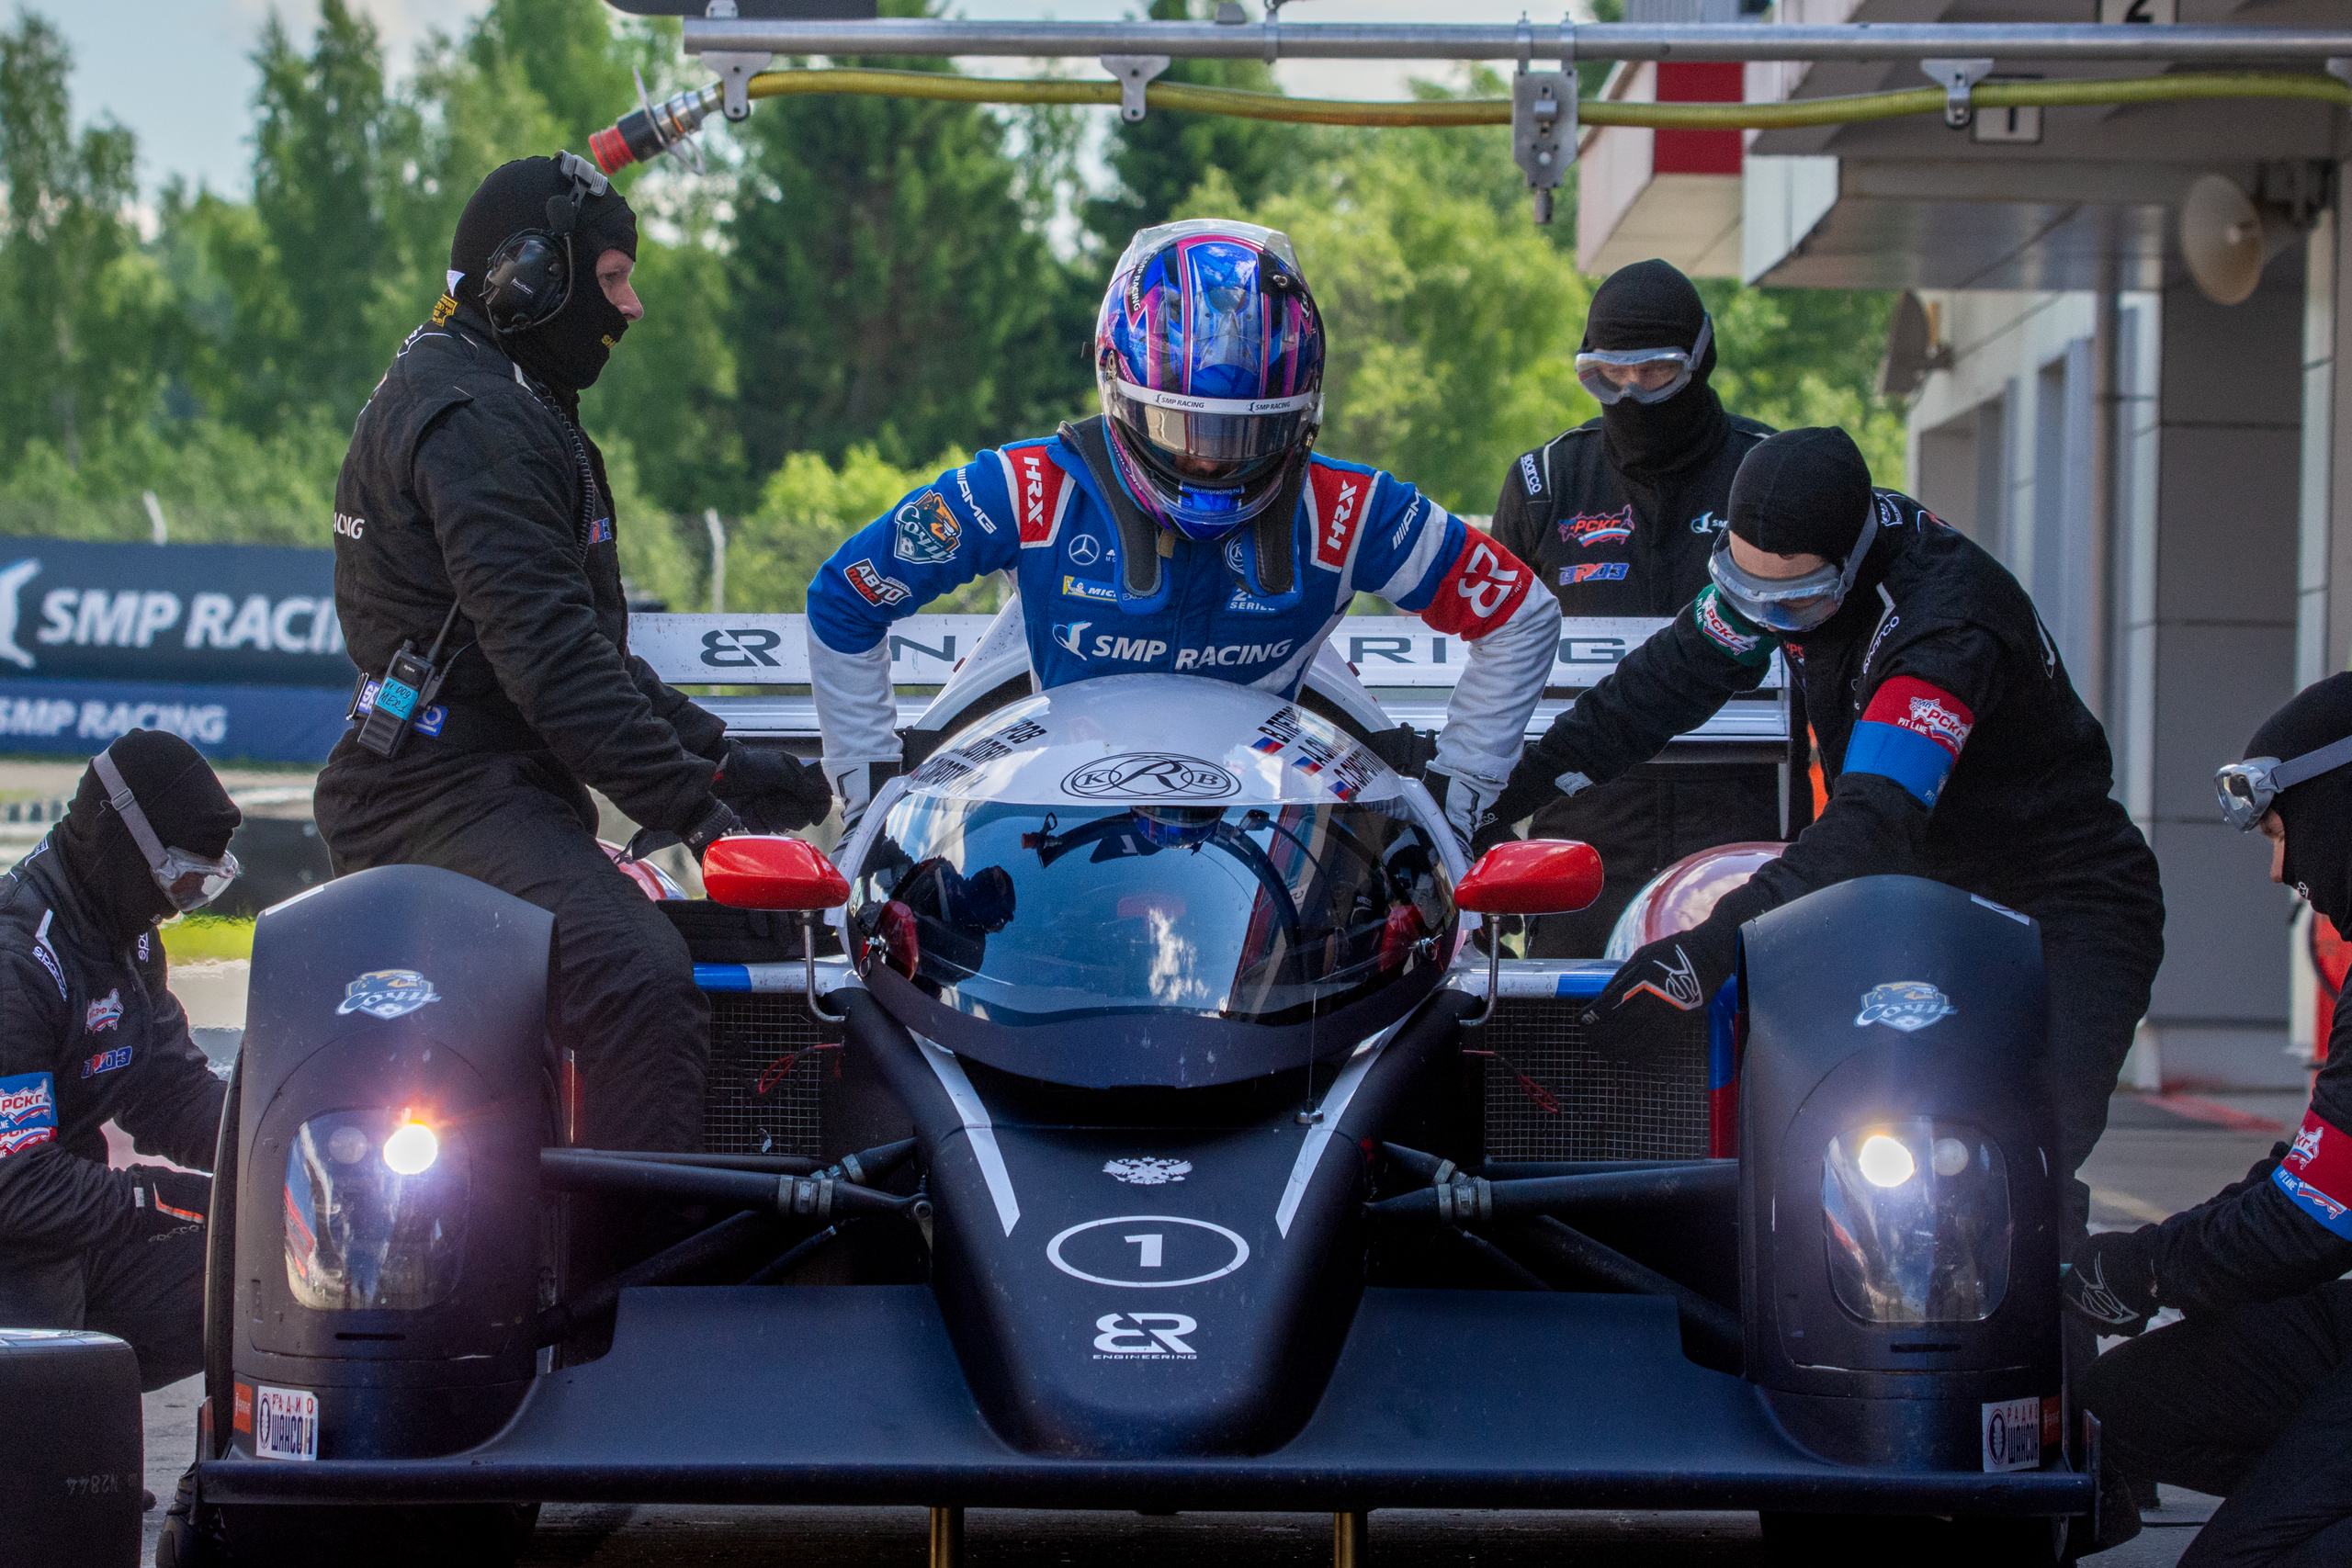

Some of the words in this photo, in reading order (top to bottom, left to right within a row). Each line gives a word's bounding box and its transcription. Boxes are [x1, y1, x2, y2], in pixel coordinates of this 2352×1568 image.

[1132, 275, 1142, 311] RACING
[1161, 396, 1176, 405] SMP
[1177, 398, 1204, 408] RACING
[1255, 402, 1271, 411] SMP
[1271, 400, 1291, 410] RACING
[1023, 456, 1044, 526] HRX
[1521, 454, 1543, 496] sparco
[957, 479, 998, 535] AMG
[1327, 479, 1358, 551] HRX
[1713, 519, 1729, 528] SM
[847, 568, 878, 601] ПЛЮС
[856, 565, 904, 602] АВТО
[37, 588, 182, 648] SMP
[1707, 608, 1744, 642] РСКГ
[1091, 635, 1167, 662] SMP
[1175, 638, 1294, 670] RACING
[1897, 717, 1910, 727] PIT
[1910, 720, 1928, 735] LANE
[1929, 709, 1964, 738] РСКГ
[2, 1094, 42, 1111] РСКГ
[1125, 1234, 1163, 1267] 1
[272, 1393, 314, 1415] РАДИО
[271, 1414, 314, 1455] ШАНСОН
